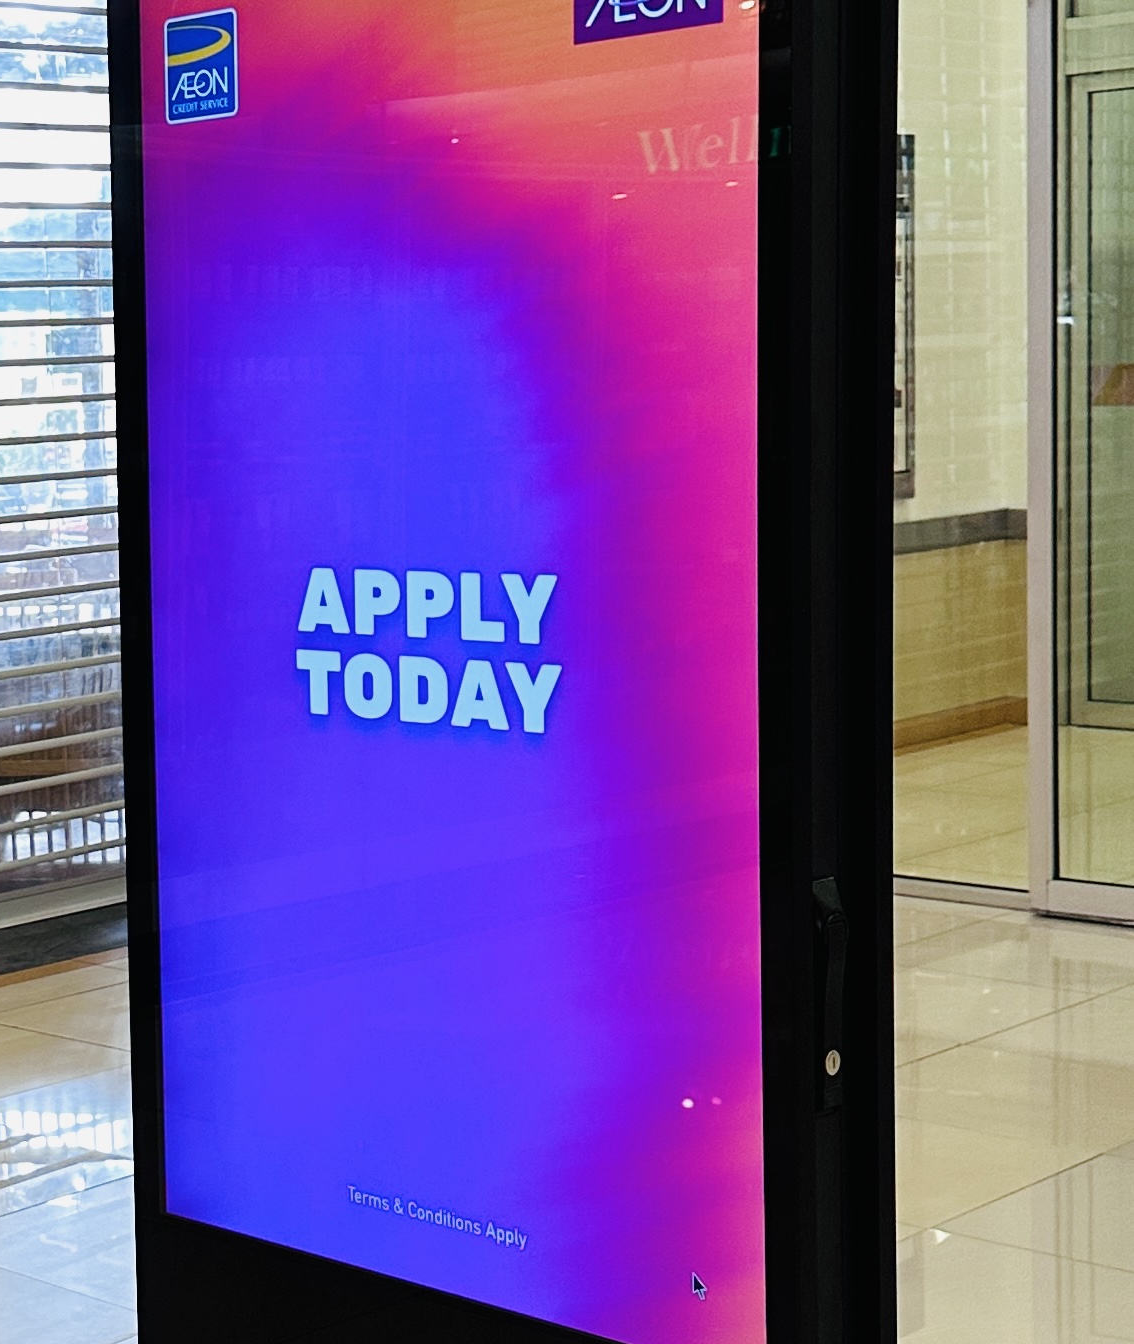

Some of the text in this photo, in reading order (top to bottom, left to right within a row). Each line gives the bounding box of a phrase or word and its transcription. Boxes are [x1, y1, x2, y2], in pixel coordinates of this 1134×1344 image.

[172, 97, 229, 115] CREDIT SERVICE
[298, 567, 558, 645] APPLY
[296, 649, 563, 734] TODAY
[347, 1185, 528, 1251] Terms & Conditions Apply
